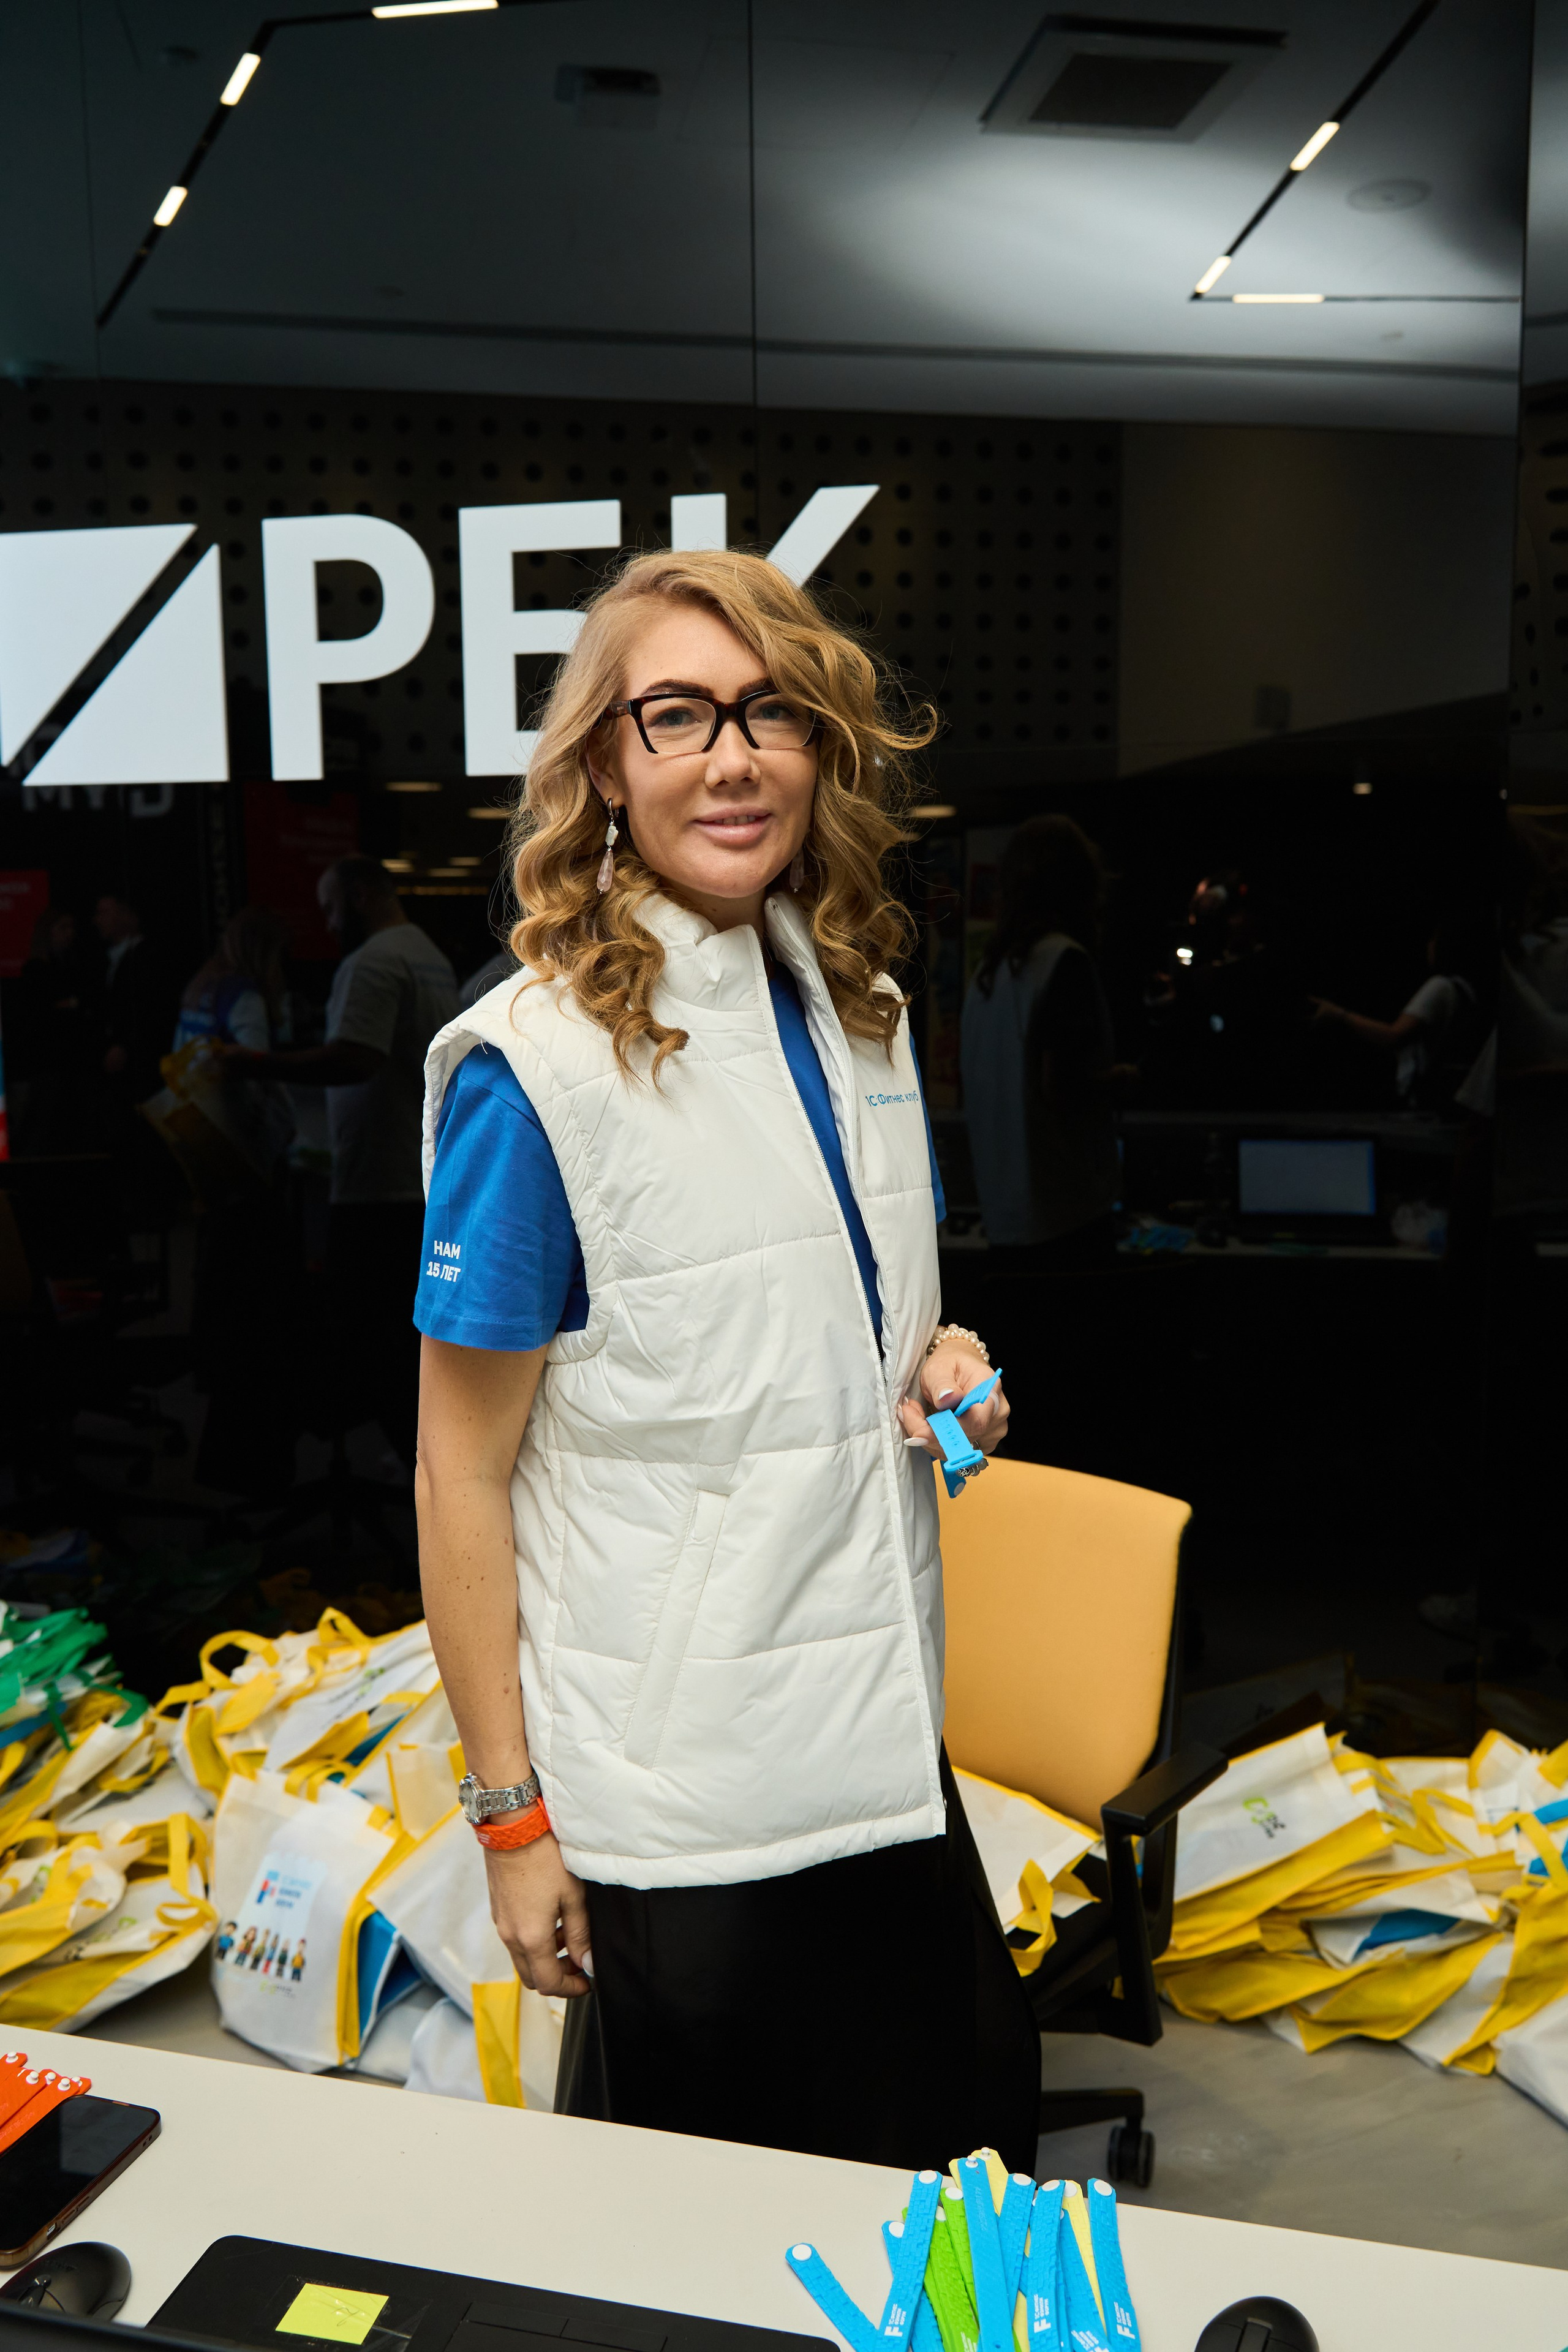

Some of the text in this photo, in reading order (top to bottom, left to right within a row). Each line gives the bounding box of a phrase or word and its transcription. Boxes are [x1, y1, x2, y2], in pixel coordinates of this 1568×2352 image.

[865, 1090, 919, 1107] 1С:Фитнес клуб
[434, 1240, 461, 1259] НАМ
[426, 1261, 461, 1283] 15 ЛЕТ
[884, 2326, 903, 2337] F
[1033, 2318, 1052, 2334] F
[1117, 2324, 1136, 2340] F
